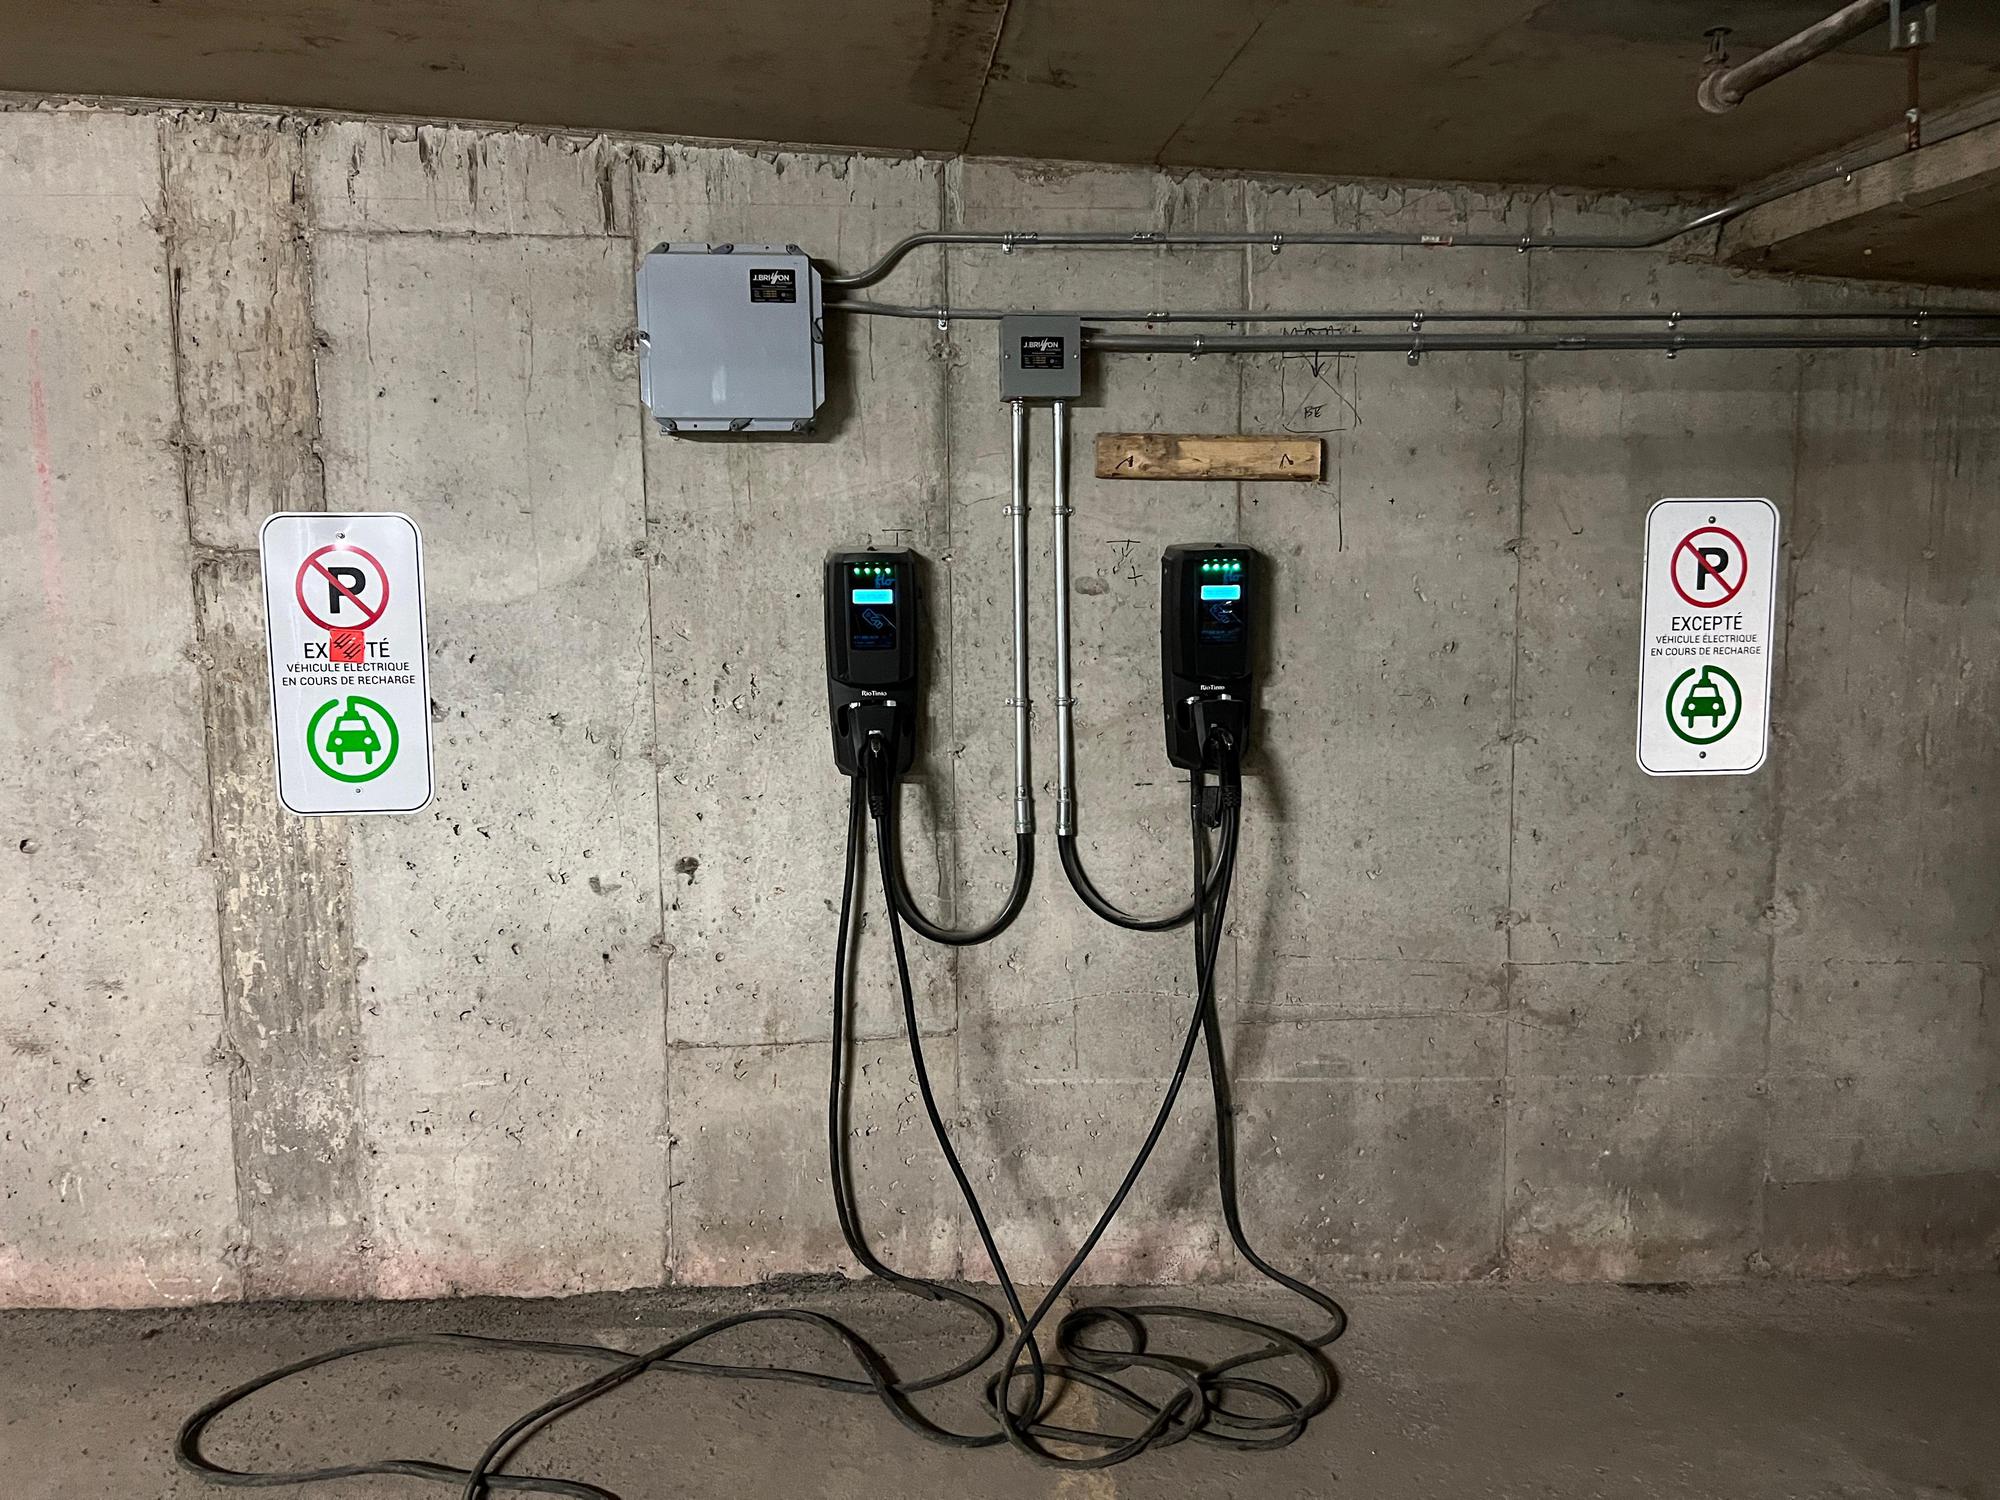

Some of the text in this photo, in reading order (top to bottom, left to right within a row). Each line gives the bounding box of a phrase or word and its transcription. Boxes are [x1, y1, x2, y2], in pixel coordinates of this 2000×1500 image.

[1697, 547, 1729, 590] P
[328, 567, 366, 614] P
[1671, 611, 1743, 631] EXCEPTÉ
[1656, 632, 1758, 644] VÉHICULE ÉLECTRIQUE
[303, 637, 391, 659] EXTÉ
[1650, 646, 1761, 657] EN COURS DE RECHARGE
[286, 661, 340, 673] VÉHICULE
[282, 674, 416, 686] EN COURS DE RECHARGE
